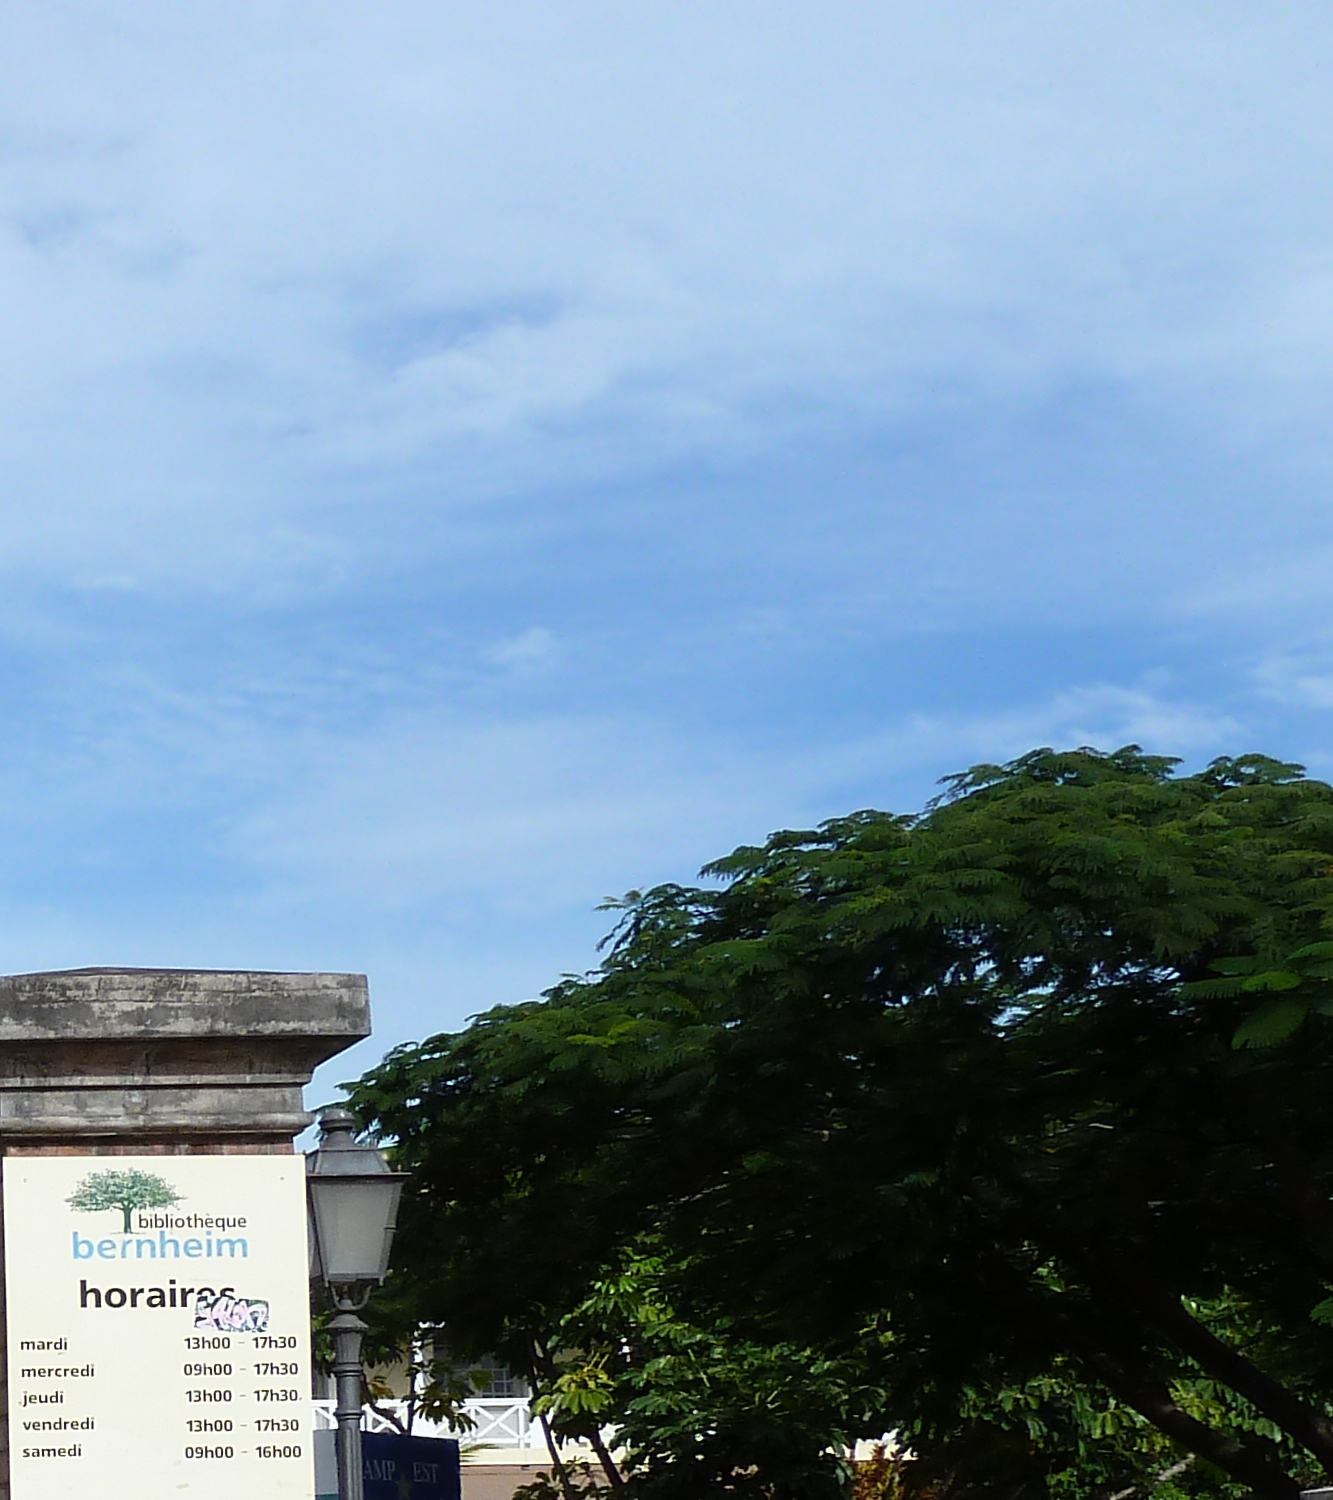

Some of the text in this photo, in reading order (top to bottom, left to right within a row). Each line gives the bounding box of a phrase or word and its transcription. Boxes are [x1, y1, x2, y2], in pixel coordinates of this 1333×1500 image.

[138, 1213, 247, 1232] bibliothèque
[72, 1230, 248, 1259] bernheim
[20, 1337, 68, 1351] mardi
[184, 1336, 231, 1349] 13h00
[252, 1336, 297, 1349] 17h30
[21, 1363, 95, 1378] mercredi
[183, 1363, 233, 1376] 09h00
[253, 1362, 298, 1375] 17h30
[22, 1390, 64, 1407] jeudi
[185, 1389, 232, 1402] 13h00
[253, 1389, 298, 1402] 17h30
[22, 1417, 95, 1431] vendredi
[186, 1419, 233, 1432] 13h00
[254, 1418, 299, 1431] 17h30
[22, 1443, 82, 1458] samedi
[185, 1446, 234, 1459] 09h00
[255, 1445, 301, 1458] 16h00
